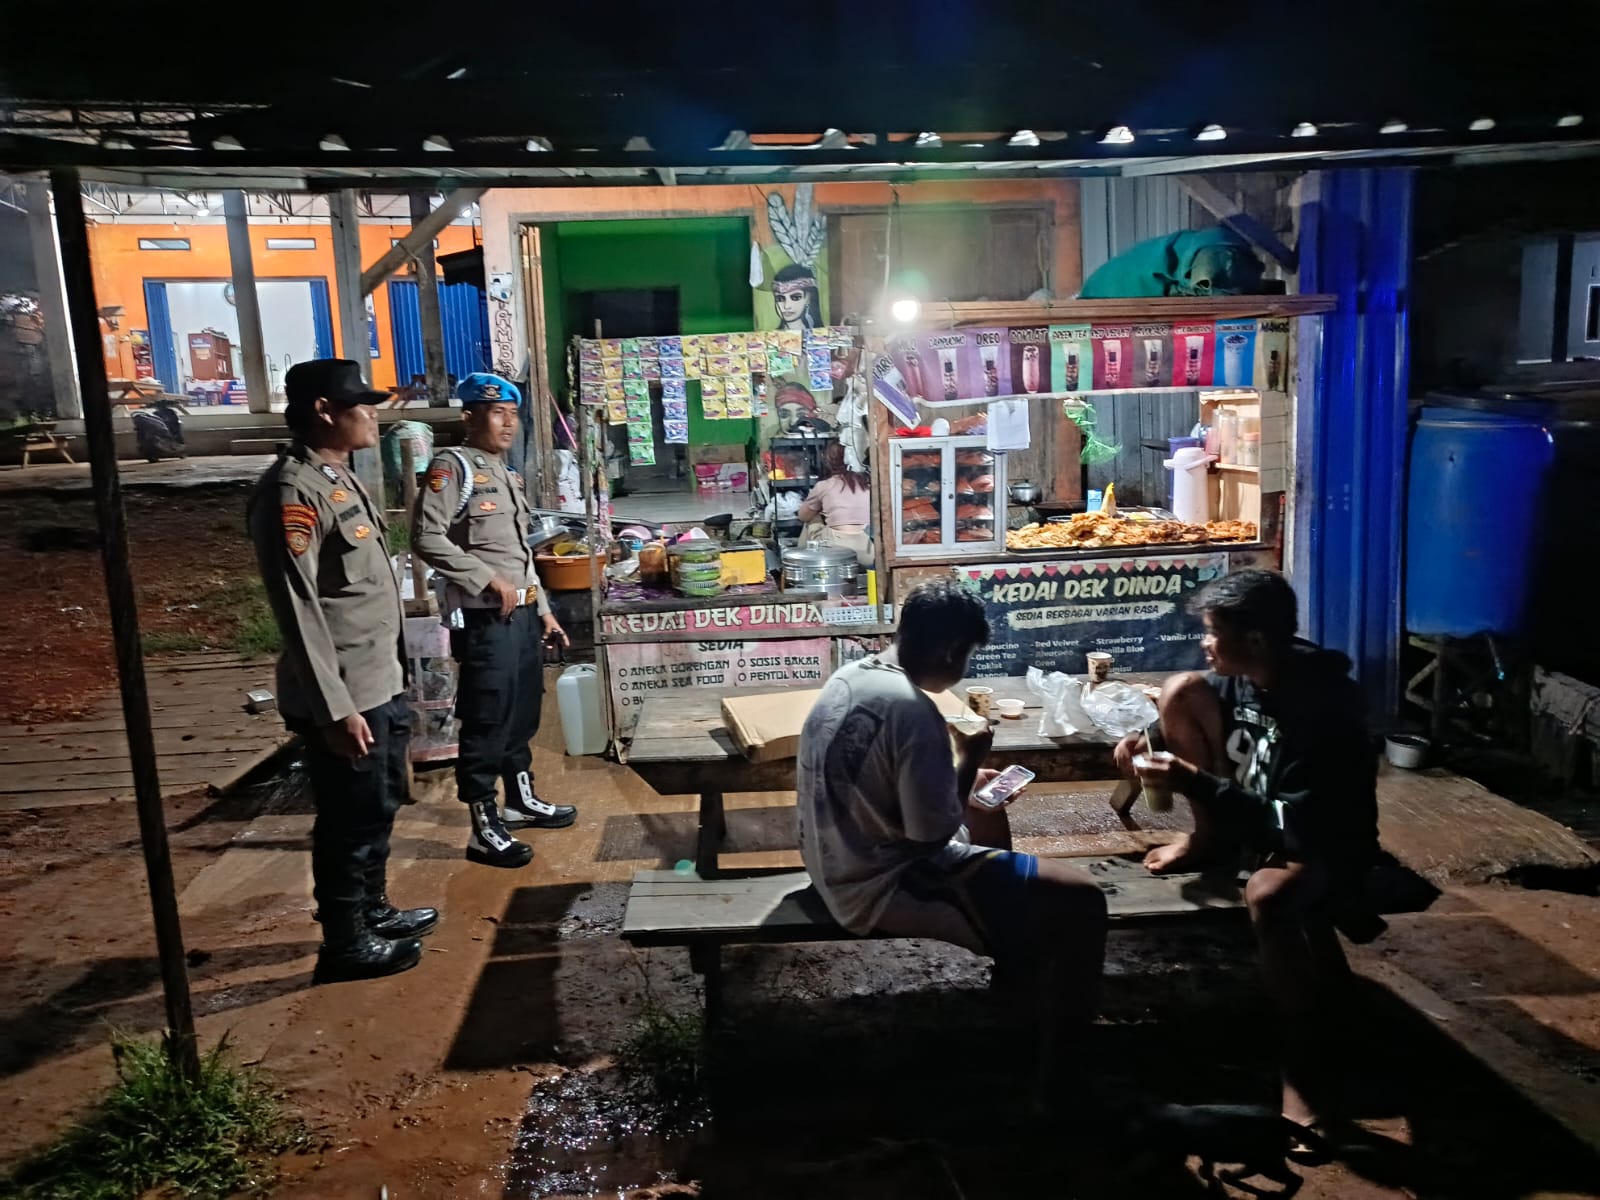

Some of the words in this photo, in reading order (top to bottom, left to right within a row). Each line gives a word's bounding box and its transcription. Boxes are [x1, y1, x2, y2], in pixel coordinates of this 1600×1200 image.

[992, 581, 1058, 605] KEDAI
[1064, 578, 1108, 600] DEK
[1114, 574, 1182, 598] DINDA
[611, 610, 687, 635] KEDAI
[694, 608, 742, 629] DEK
[749, 603, 825, 626] DINDA
[1015, 609, 1043, 621] SEDIA
[1046, 607, 1093, 620] BERBAGAI
[1096, 605, 1131, 617] VARIAN
[1134, 604, 1160, 615] RASA
[699, 640, 744, 652] SEDIA
[1034, 640, 1051, 648] Red
[1053, 639, 1080, 648] Velvet
[1095, 636, 1144, 647] Strawberry
[750, 656, 781, 667] SOSIS
[784, 655, 820, 667] BAKAR
[976, 652, 1001, 661] Green
[1002, 652, 1017, 660] Tea
[630, 664, 667, 678] ANEKA
[671, 659, 730, 675] GORENGAN
[631, 677, 669, 691] ANEKA
[672, 675, 694, 688] SEA
[697, 673, 726, 686] FOOD
[750, 671, 790, 683] PENTOL
[792, 669, 822, 681] KUAH
